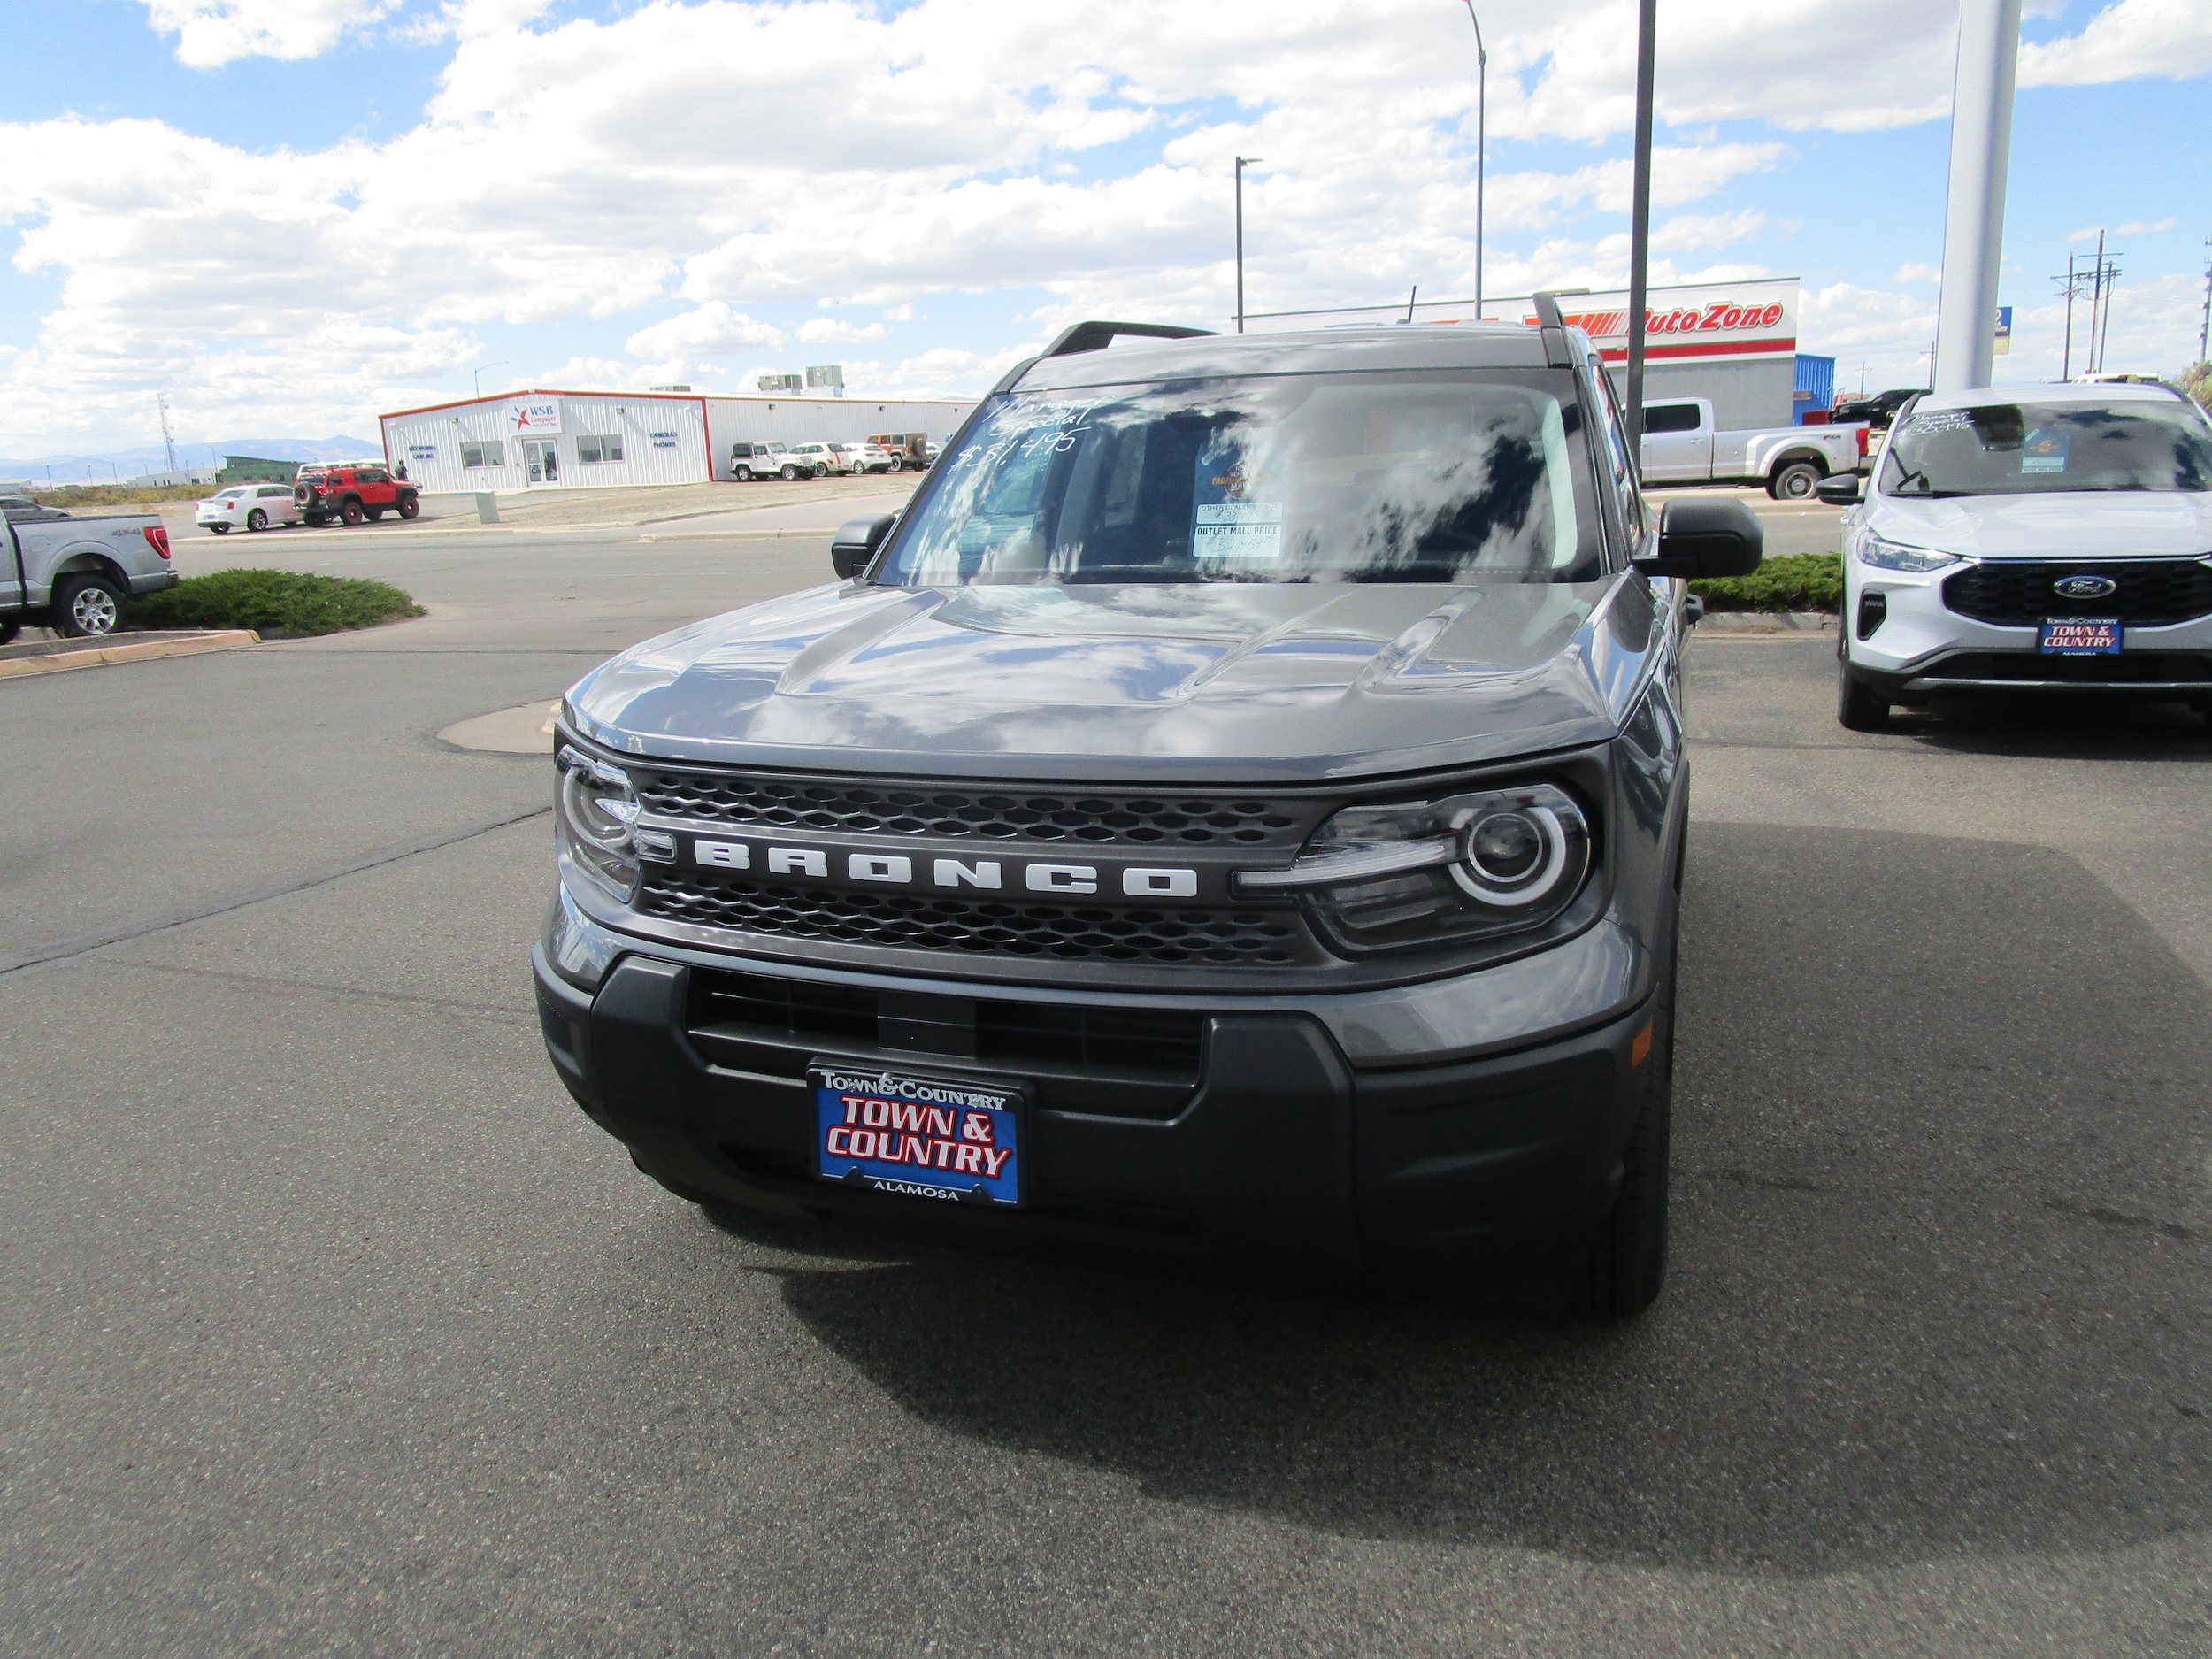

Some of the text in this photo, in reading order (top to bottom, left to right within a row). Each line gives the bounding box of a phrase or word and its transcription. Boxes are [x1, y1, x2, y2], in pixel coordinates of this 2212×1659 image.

[530, 405, 554, 416] WSB
[982, 395, 1116, 422] Manager
[990, 408, 1091, 440] Special
[2068, 580, 2101, 594] Ford
[2043, 636, 2116, 647] COUNTRY
[2052, 626, 2110, 636] TOWN &
[694, 839, 1197, 897] BRONCO
[841, 1095, 994, 1142] TOWN &
[826, 1126, 1011, 1179] COUNTRY
[873, 1179, 960, 1202] ALAMOSA
